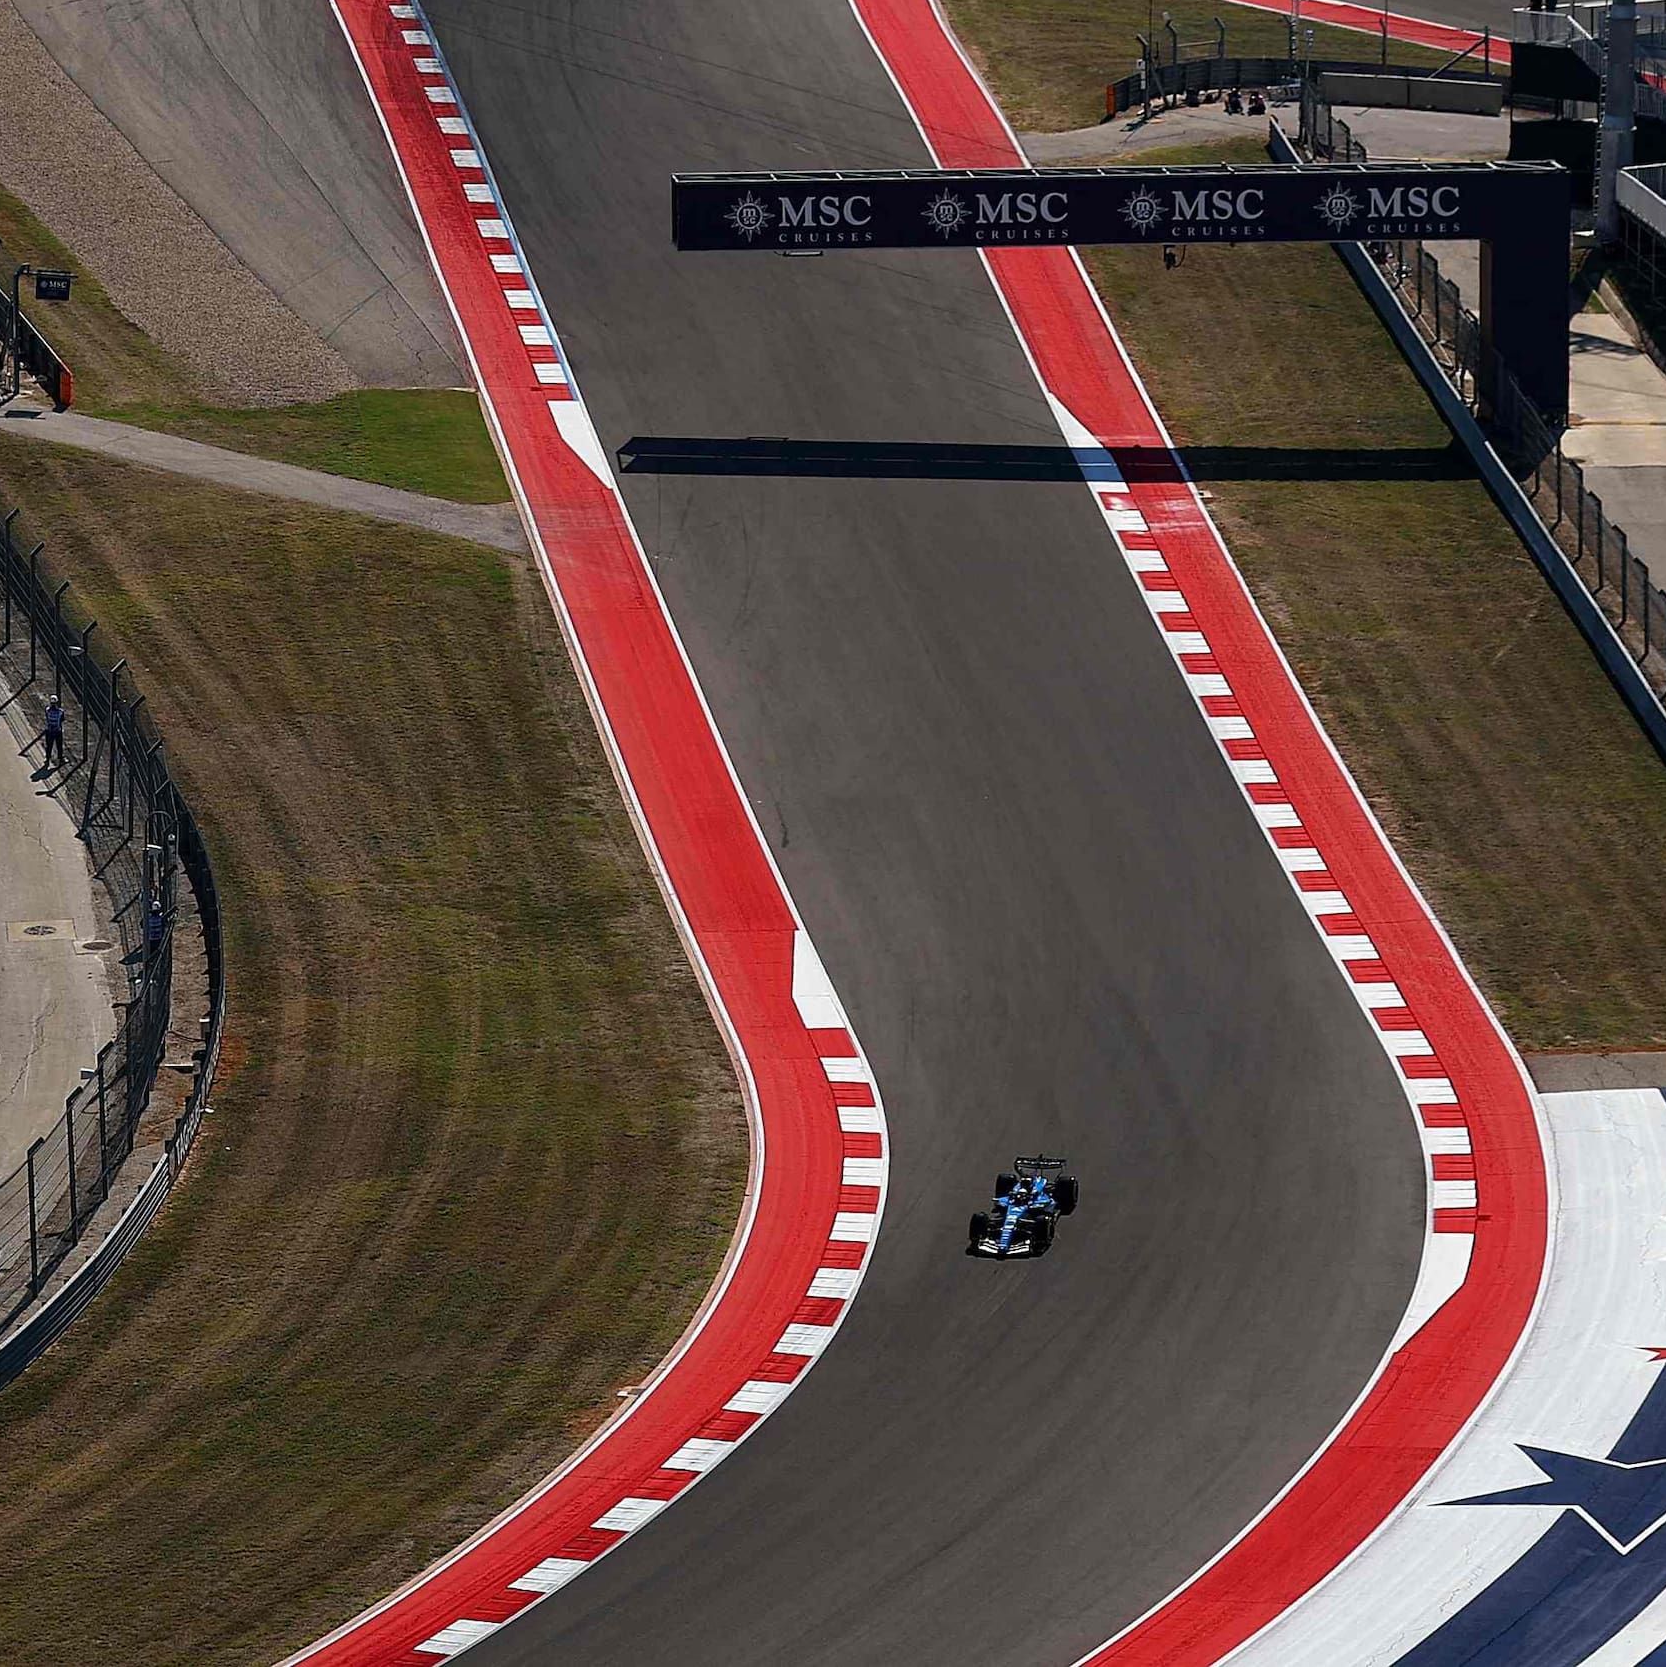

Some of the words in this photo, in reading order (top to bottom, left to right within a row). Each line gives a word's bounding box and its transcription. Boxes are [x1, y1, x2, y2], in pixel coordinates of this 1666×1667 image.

[778, 196, 872, 227] MSC
[974, 191, 1069, 225] MSC
[1171, 188, 1265, 221] MSC
[1367, 185, 1461, 219] MSC
[779, 232, 873, 243] CRUISES
[975, 228, 1069, 240] CRUISES
[1171, 224, 1265, 237] CRUISES
[1367, 221, 1461, 234] CRUISES
